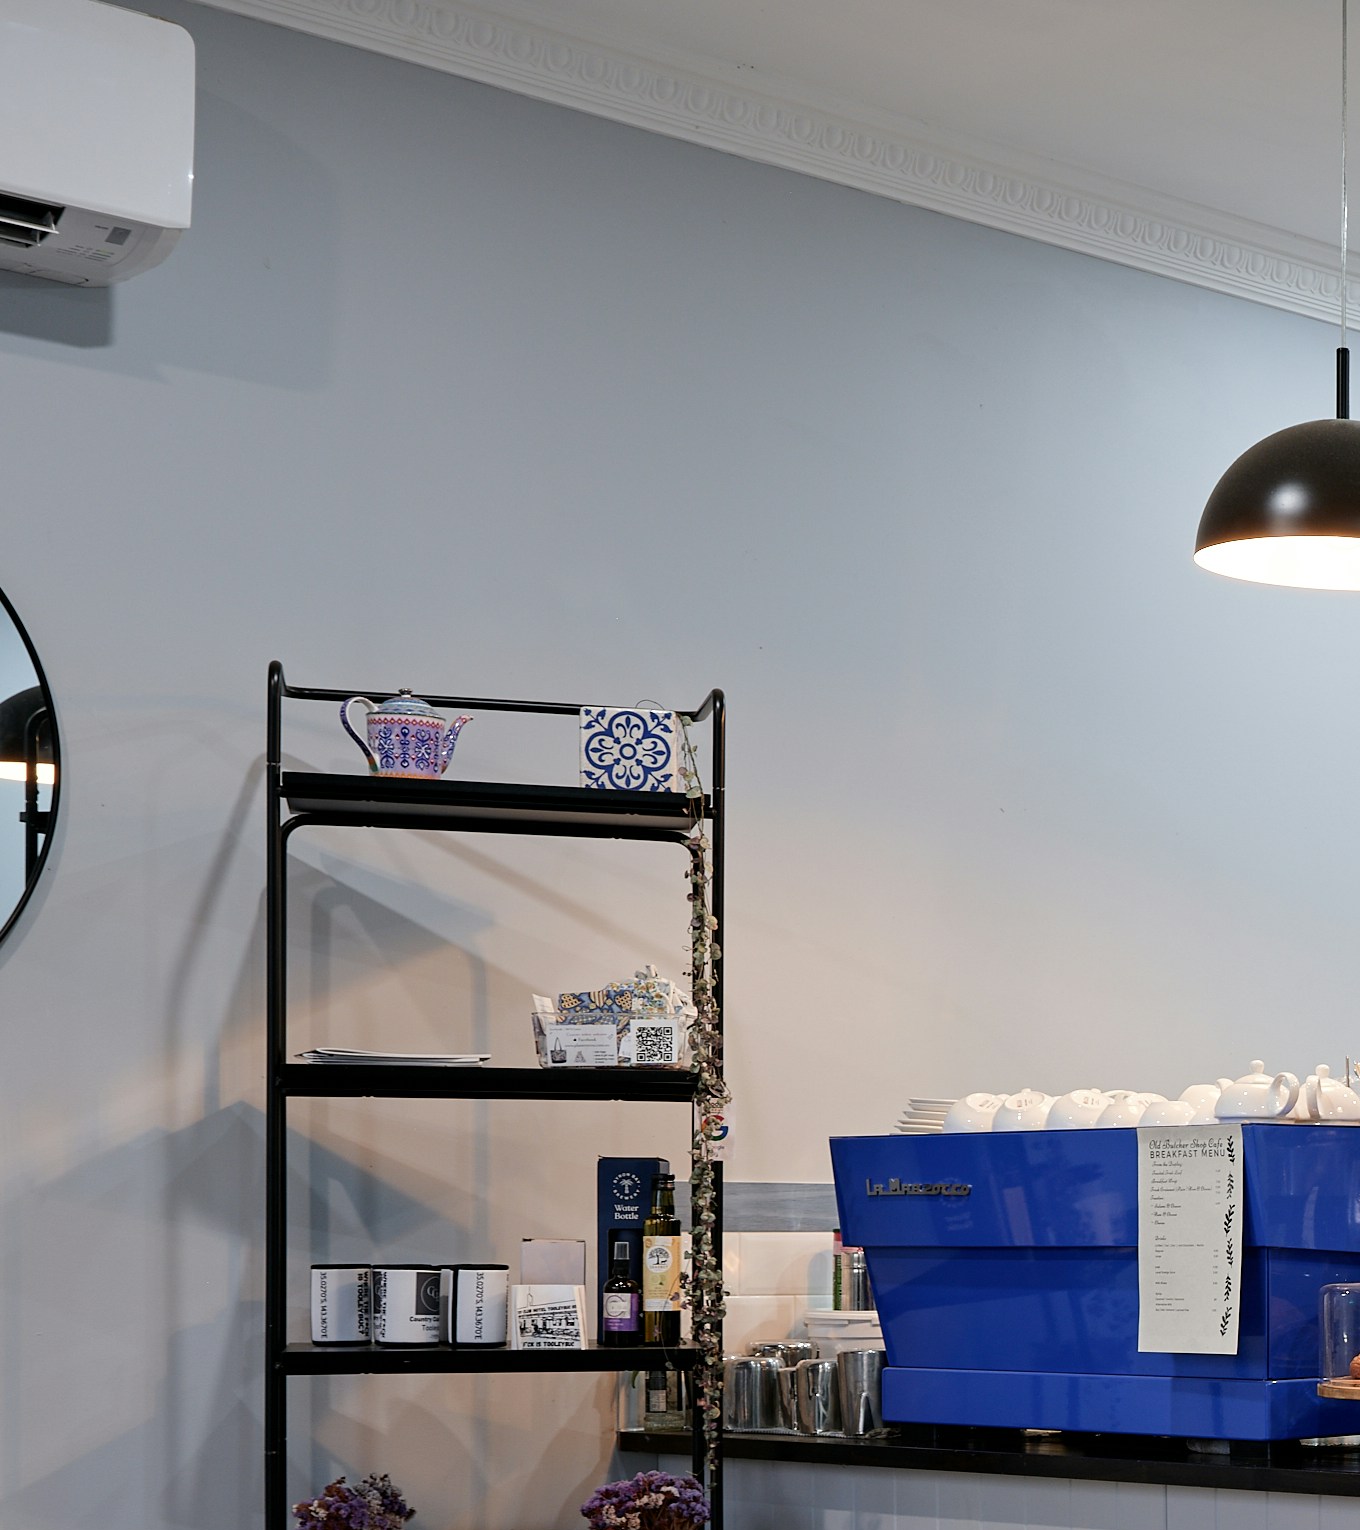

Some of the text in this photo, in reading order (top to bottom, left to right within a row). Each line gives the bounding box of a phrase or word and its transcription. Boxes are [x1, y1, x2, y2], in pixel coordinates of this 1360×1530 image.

[1149, 1137, 1223, 1151] Old Butcher Shop Cafe
[1150, 1149, 1226, 1159] BREAKFAST MENU
[613, 1204, 640, 1212] Water
[614, 1212, 640, 1220] Bottle
